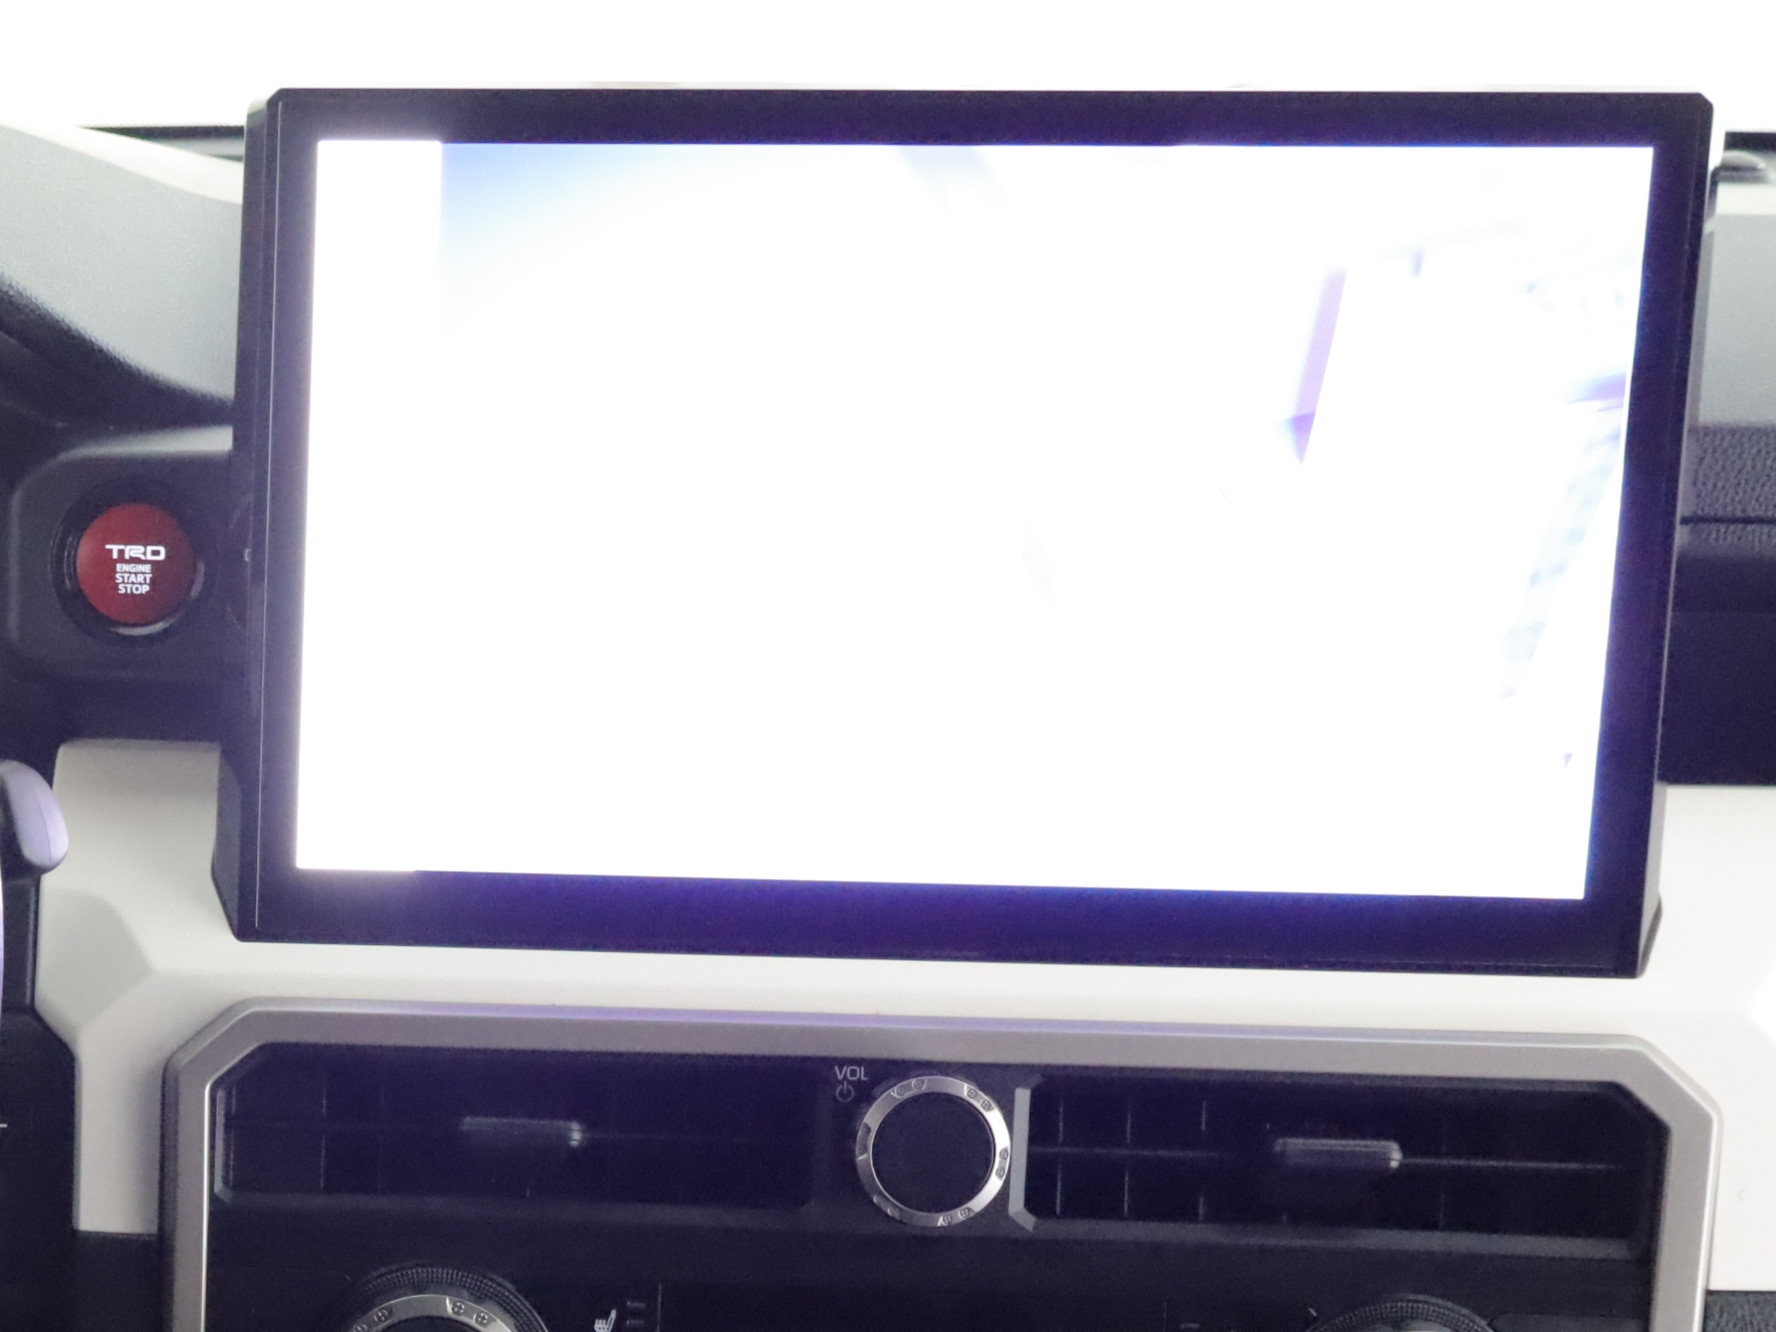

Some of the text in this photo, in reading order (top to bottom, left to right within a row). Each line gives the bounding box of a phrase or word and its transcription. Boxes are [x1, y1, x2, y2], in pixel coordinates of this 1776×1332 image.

[105, 544, 166, 561] TRD
[115, 563, 152, 573] ENGINE
[115, 573, 153, 584] START
[118, 584, 150, 595] STOP
[834, 1066, 869, 1082] VOL
